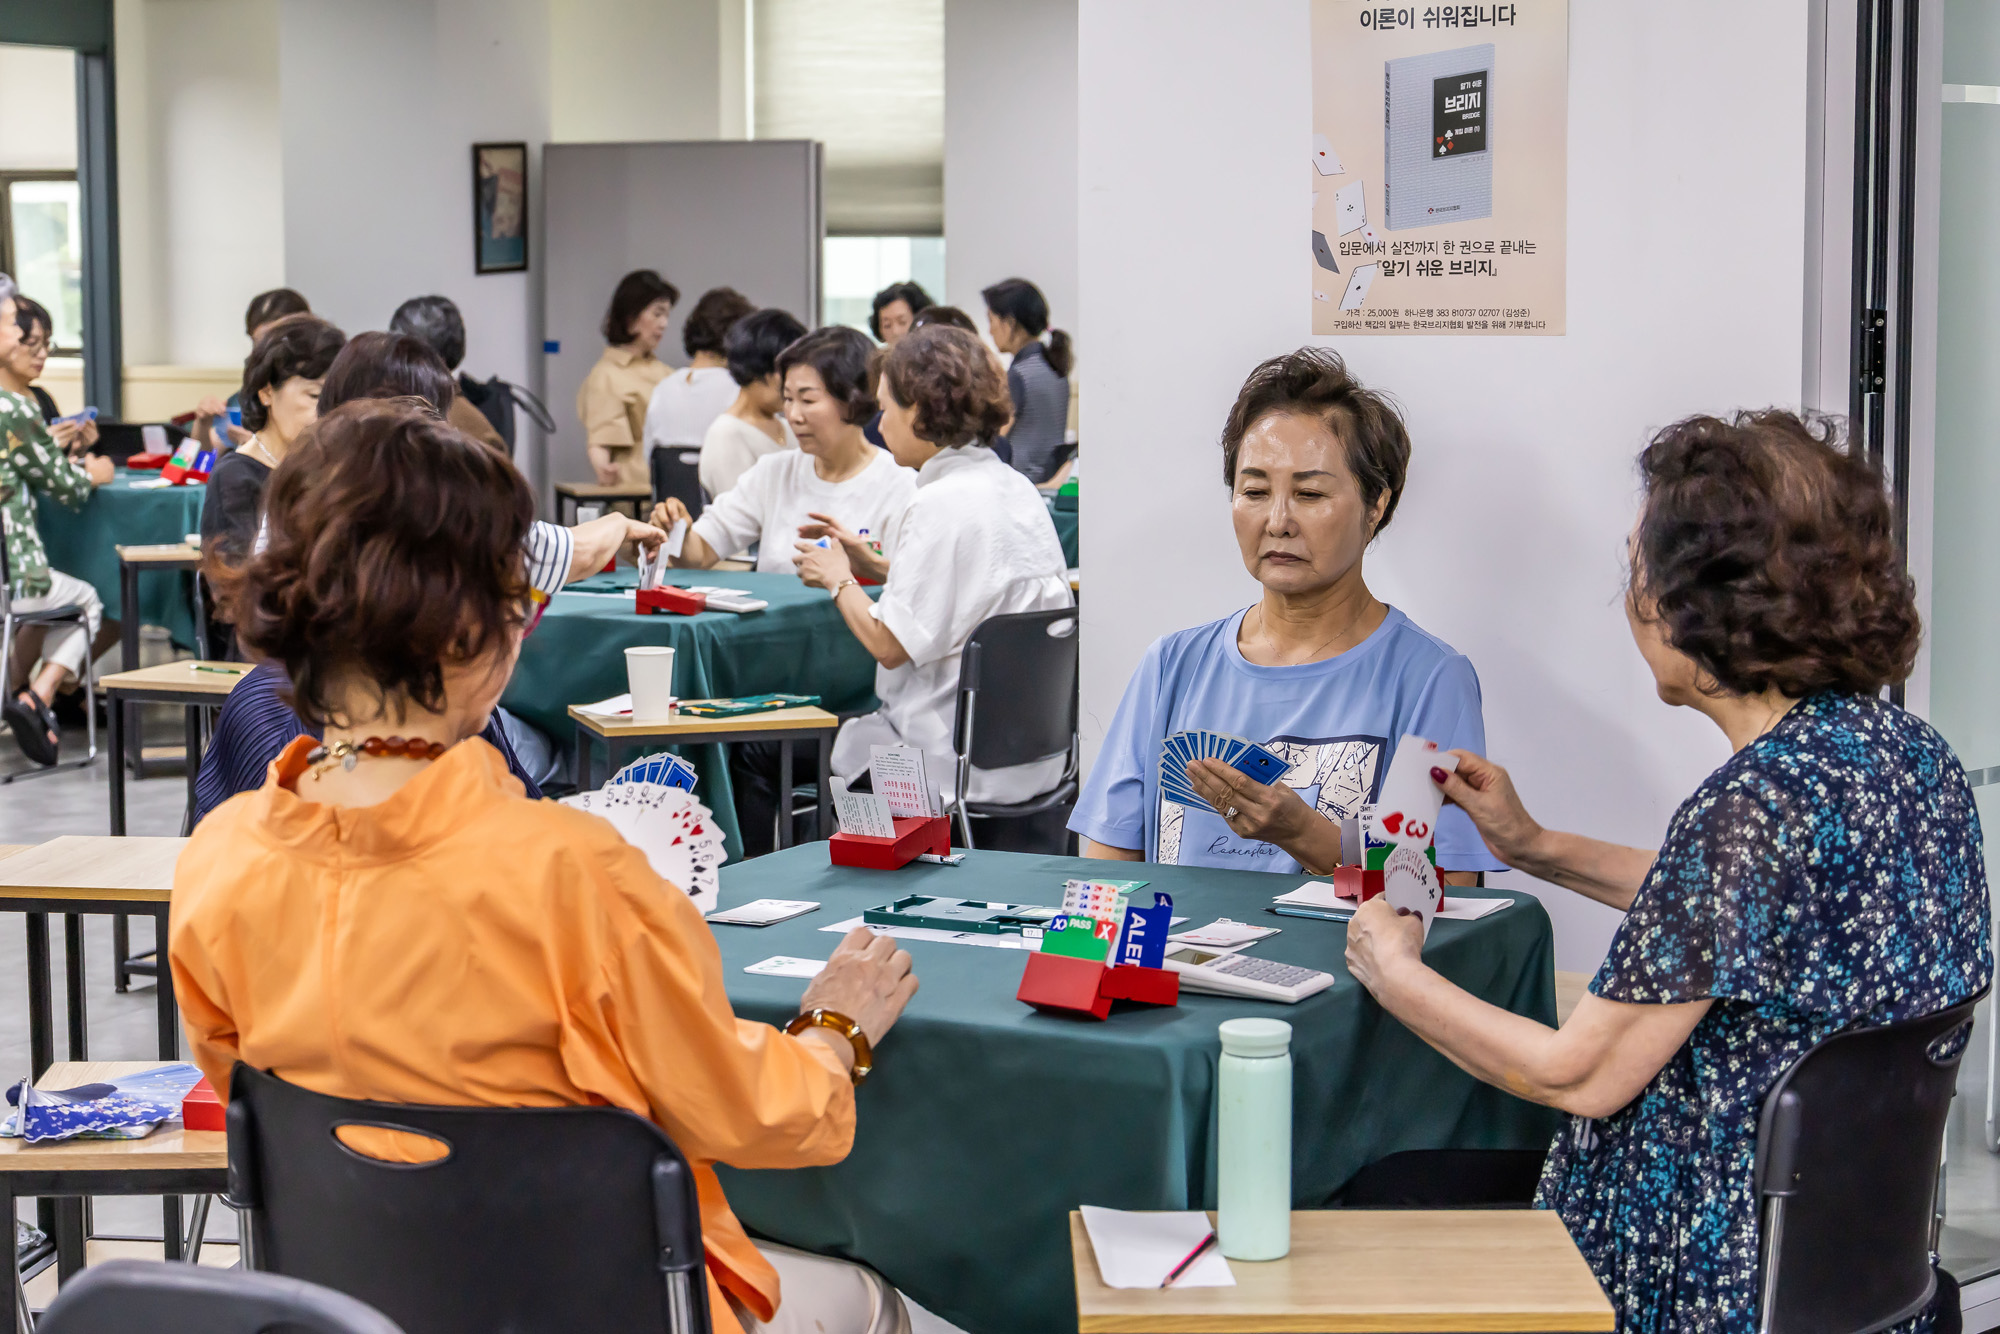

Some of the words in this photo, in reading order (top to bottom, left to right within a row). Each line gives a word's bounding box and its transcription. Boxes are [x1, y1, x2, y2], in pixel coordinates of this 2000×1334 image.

[1360, 8, 1415, 30] 이론이
[1423, 4, 1517, 29] 쉬워집니다
[1444, 91, 1481, 114] 브리지
[1462, 111, 1481, 120] BRIDGE
[1340, 241, 1386, 255] 입문에서
[1391, 241, 1438, 255] 실전까지
[1443, 240, 1456, 255] 한
[1460, 240, 1496, 254] 권으로
[1500, 240, 1537, 254] 끝내는
[1415, 259, 1444, 277] 쉬운
[1346, 309, 1361, 317] 가격
[1367, 309, 1400, 317] 25,000원
[1404, 309, 1434, 317] 하나은행
[1436, 309, 1450, 317] 383
[1452, 309, 1476, 317] 810737
[1478, 309, 1500, 317] 02707
[1503, 308, 1531, 318] (김성준)
[1334, 320, 1362, 330] 구입하신
[1389, 320, 1410, 330] 일부는
[1413, 320, 1464, 330] 한국브리지협회
[1466, 320, 1489, 330] 발전을
[1491, 320, 1507, 330] 위해
[1509, 320, 1546, 330] 기부합니다
[607, 788, 615, 800] 5
[625, 786, 635, 798] 9
[641, 785, 650, 797] Q
[1405, 819, 1428, 839] 3
[1069, 918, 1092, 930] PASS
[1098, 924, 1113, 940] X
